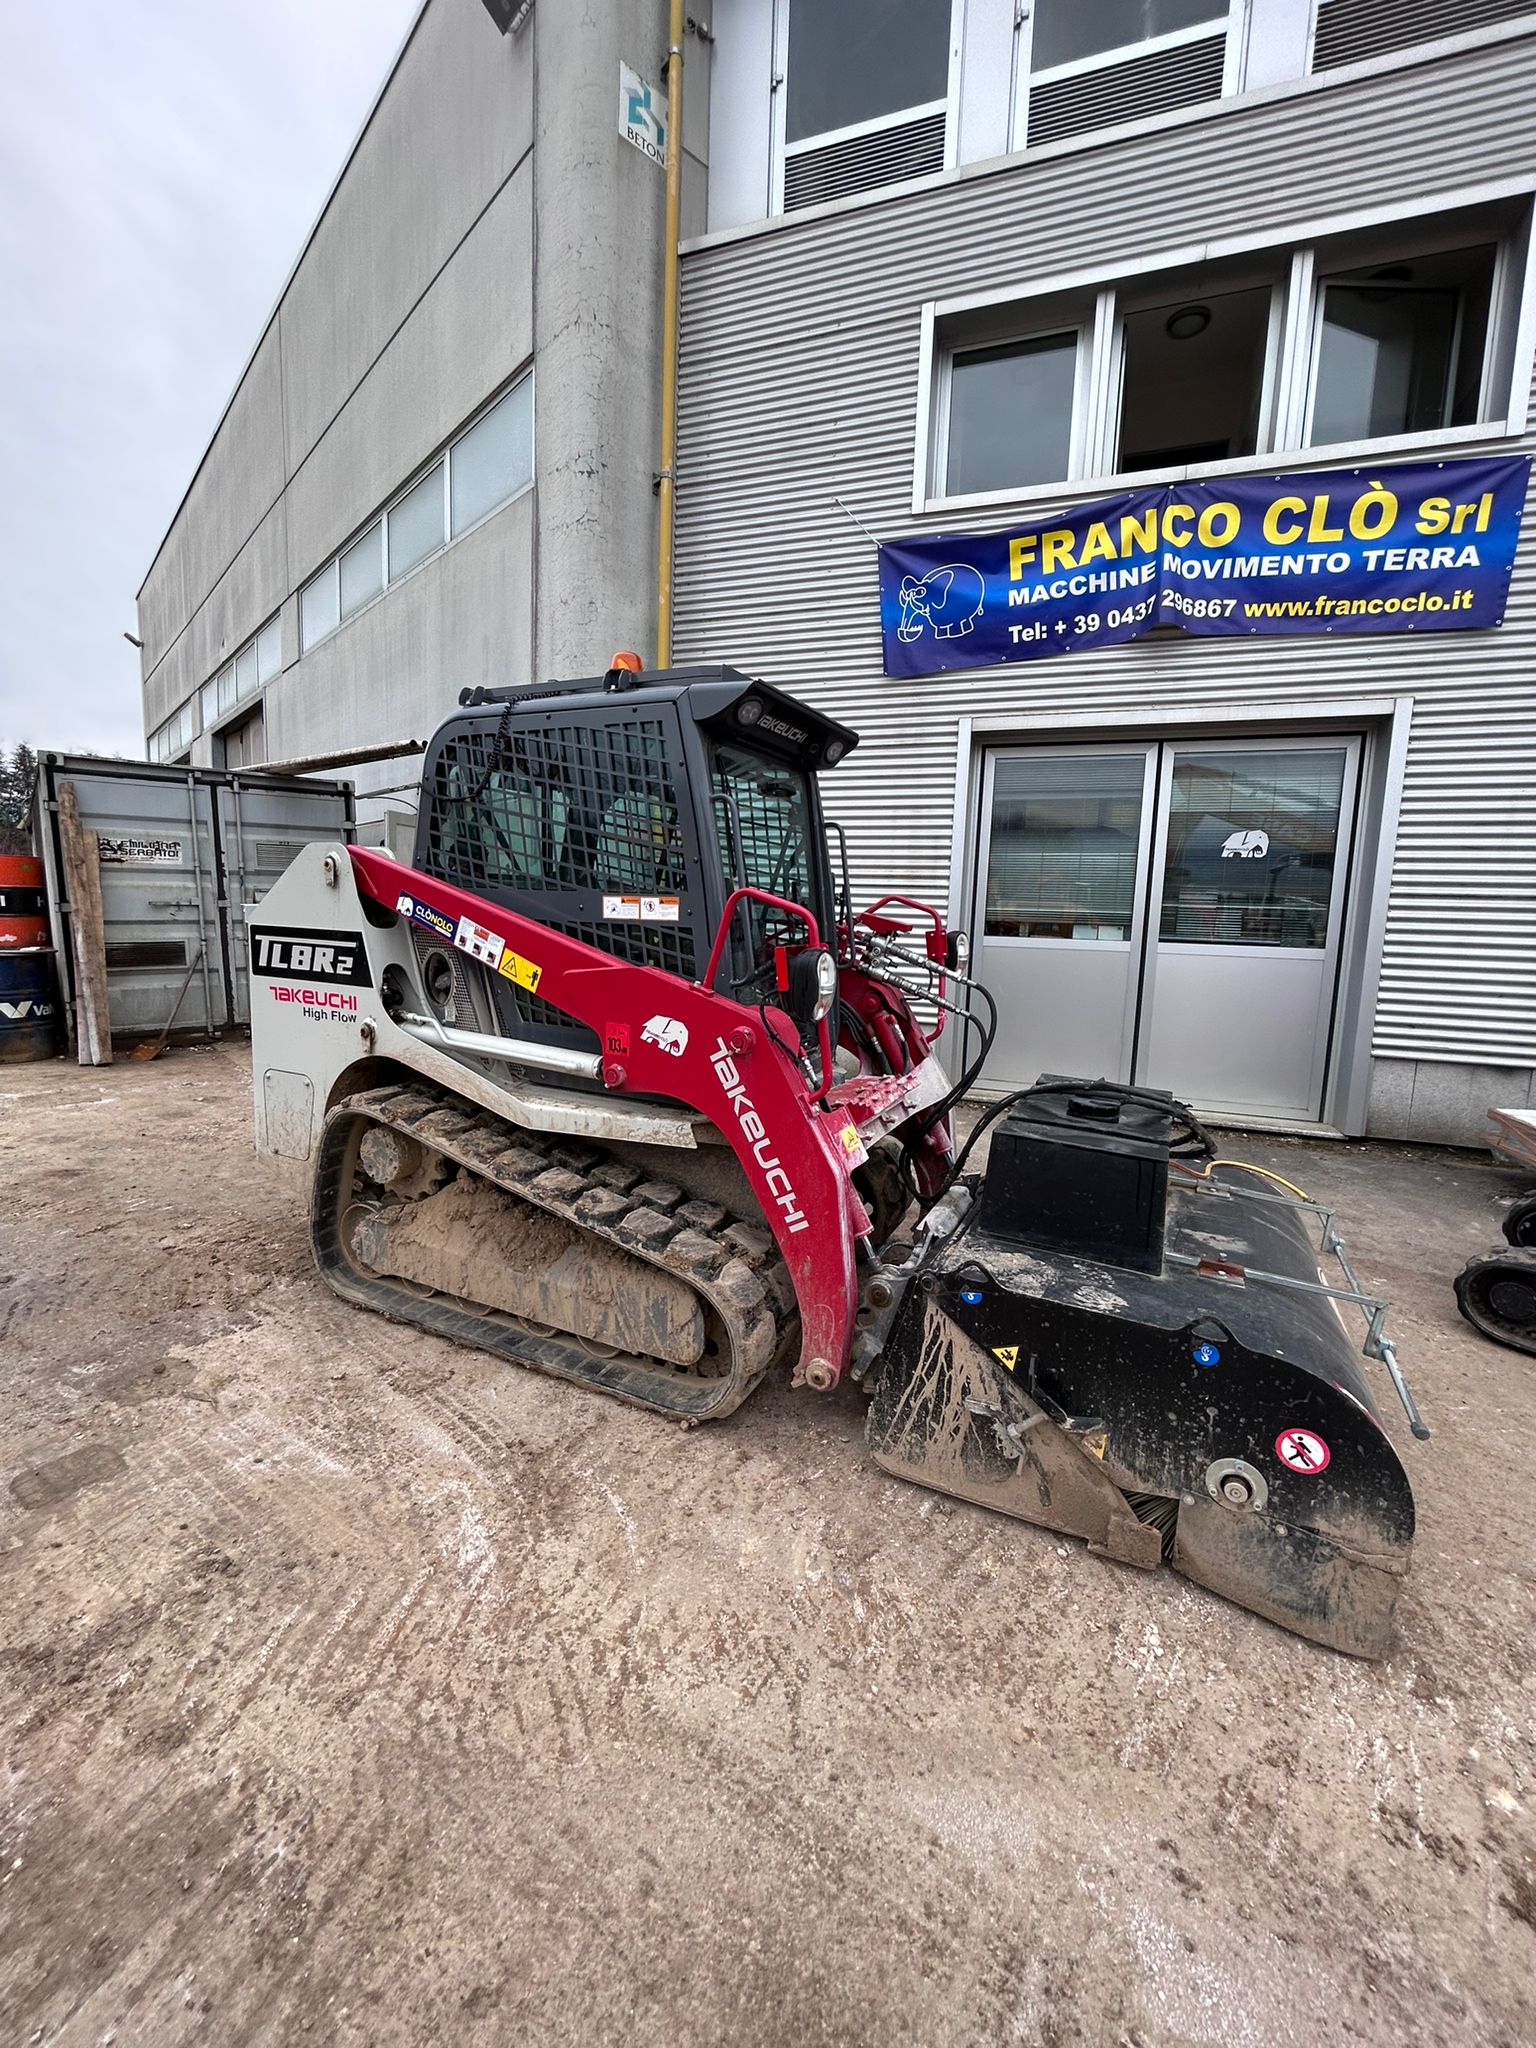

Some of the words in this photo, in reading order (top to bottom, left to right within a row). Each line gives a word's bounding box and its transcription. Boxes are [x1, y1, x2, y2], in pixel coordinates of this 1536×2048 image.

[627, 126, 665, 165] BETON
[1009, 502, 1241, 581] FRANCO
[1262, 480, 1398, 545] CLÒ
[1415, 493, 1494, 535] Srl
[1008, 560, 1156, 606] MACCHINE
[1163, 552, 1350, 579] MOVIMENTO
[1362, 545, 1480, 572] TERRA
[1008, 622, 1047, 643] Tel:
[1074, 613, 1100, 634] 39
[1107, 594, 1156, 628] 0437
[1162, 589, 1237, 618] 296867
[1243, 589, 1473, 618] www.francoclo.it
[255, 934, 357, 975] TL8R2
[33, 1004, 54, 1016] Val
[303, 1007, 328, 1021] High
[331, 1010, 357, 1023] Flow
